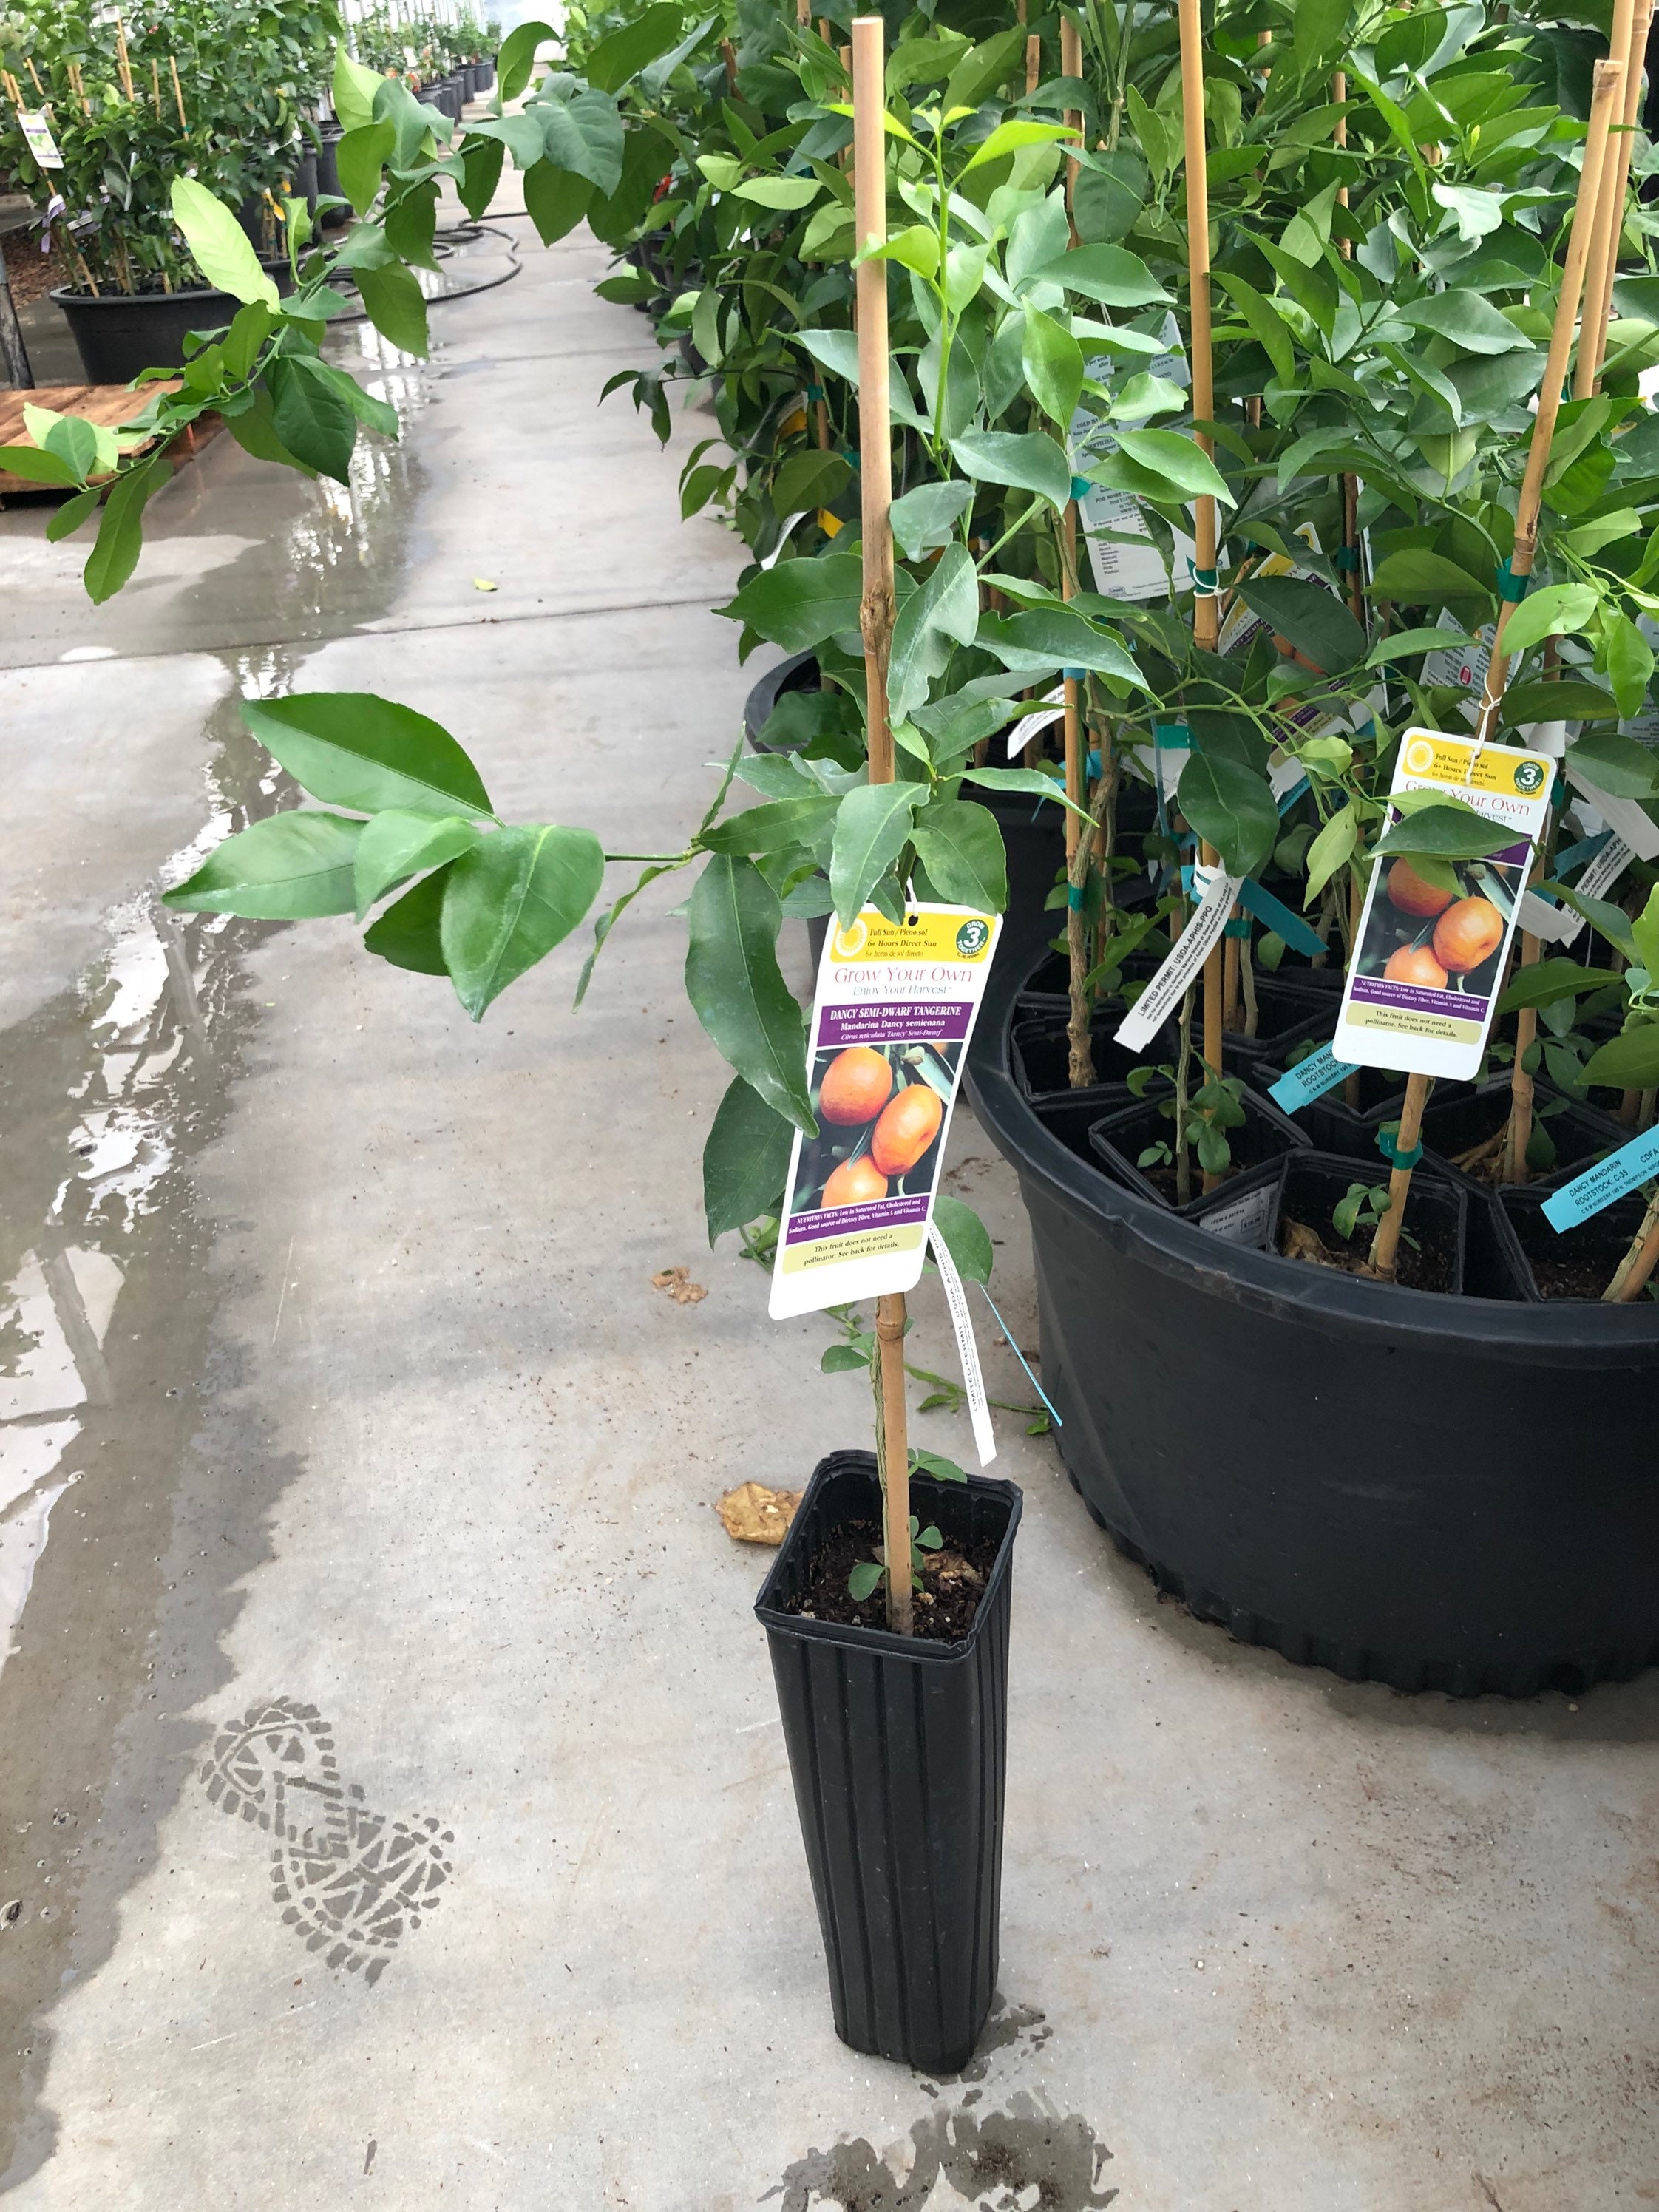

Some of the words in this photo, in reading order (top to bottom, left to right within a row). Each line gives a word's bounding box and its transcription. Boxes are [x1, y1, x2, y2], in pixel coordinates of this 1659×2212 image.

[1447, 755, 1458, 764] Sun
[1443, 764, 1462, 773] Hours
[1521, 768, 1536, 785] 3
[1491, 798, 1530, 816] Own
[963, 927, 981, 948] 3
[835, 968, 881, 983] Grow
[887, 967, 926, 982] Your
[931, 967, 972, 982] Own
[853, 986, 881, 996] Enjoy
[883, 985, 906, 994] Your
[1361, 980, 1385, 989] NUTRITION
[1415, 989, 1436, 998] Saturated
[1445, 994, 1470, 1004] Cholesterol
[1138, 991, 1158, 1016] LIMITED
[830, 1008, 858, 1020] DANCY
[858, 1006, 912, 1019] SEMI-DWARF
[913, 1005, 962, 1016] TANGERINE
[1390, 1012, 1402, 1020] fruit
[1404, 1014, 1418, 1022] does
[1431, 1019, 1446, 1027] need
[841, 1021, 879, 1031] Mandarina
[881, 1020, 905, 1029] Dancy
[1365, 1017, 1396, 1028] pollinator.
[1409, 1024, 1423, 1032] back
[1436, 1028, 1458, 1038] details.
[1295, 1061, 1317, 1079] DANCY
[1569, 1179, 1589, 1197] DANCY
[1590, 1159, 1621, 1183] MANDARIN
[1613, 1169, 1628, 1181] C-35
[1592, 1192, 1611, 1206] NURSERY
[797, 1212, 823, 1224] NUTRITION
[855, 1205, 877, 1214] Saturated
[886, 1200, 912, 1209] Cholesterol
[815, 1244, 828, 1252] This
[830, 1242, 844, 1250] fruit
[804, 1254, 836, 1266] pollinator.
[967, 1369, 977, 1412] LIMITED
